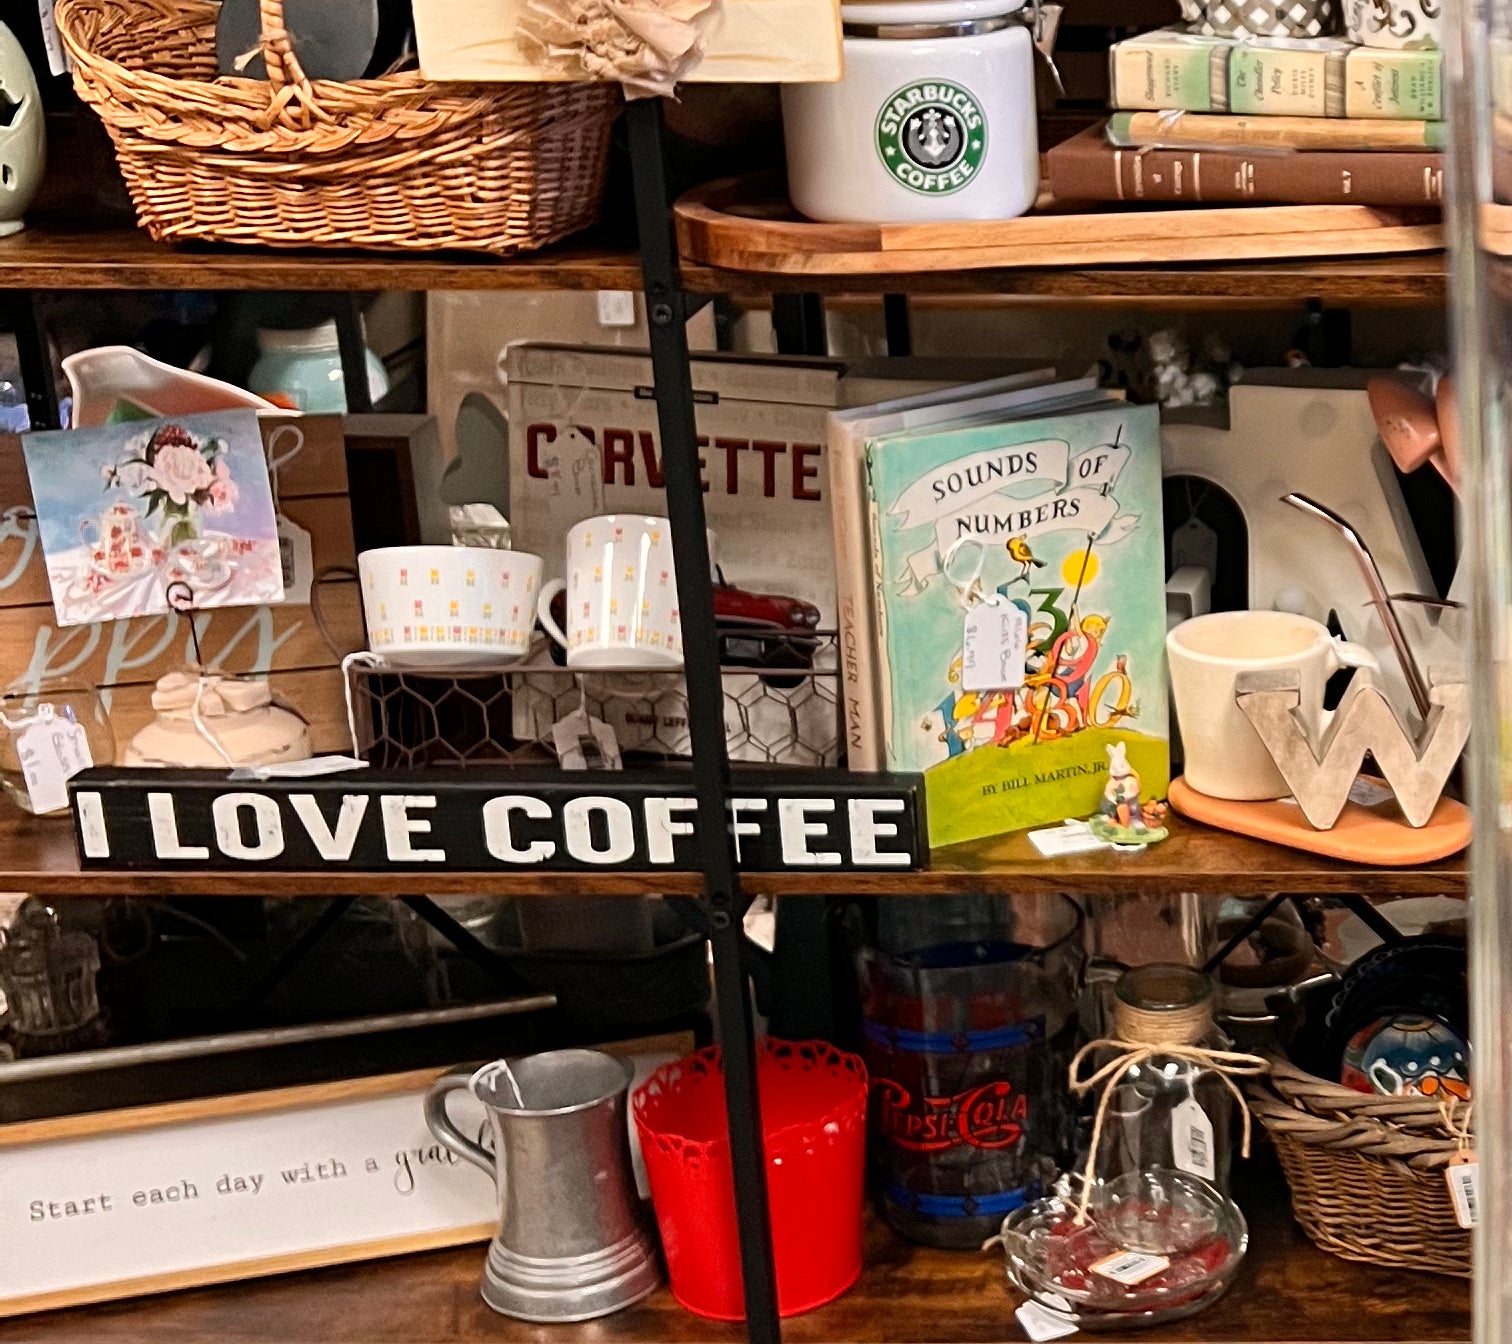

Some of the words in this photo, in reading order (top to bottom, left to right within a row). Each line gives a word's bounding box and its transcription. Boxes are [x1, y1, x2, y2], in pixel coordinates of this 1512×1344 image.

[880, 84, 982, 136] STARBUCKS
[896, 158, 975, 190] COFFEE
[526, 423, 822, 501] CRVETTE
[932, 451, 1038, 502] SOUNDS
[1079, 455, 1109, 479] OF
[956, 497, 1081, 539] NUMBERS
[842, 594, 858, 683] TEACHER
[848, 697, 862, 749] MAN
[982, 782, 998, 796] BY
[1002, 777, 1031, 792] BILL
[1034, 765, 1092, 785] MARTIN,
[1092, 760, 1108, 775] JR.
[75, 792, 109, 859] I
[148, 793, 447, 864] LOVE
[482, 797, 912, 867] COFFEE
[30, 1192, 113, 1223] Start
[131, 1180, 199, 1209] each
[215, 1172, 264, 1197] day
[281, 1159, 346, 1186] with
[364, 1157, 380, 1172] a
